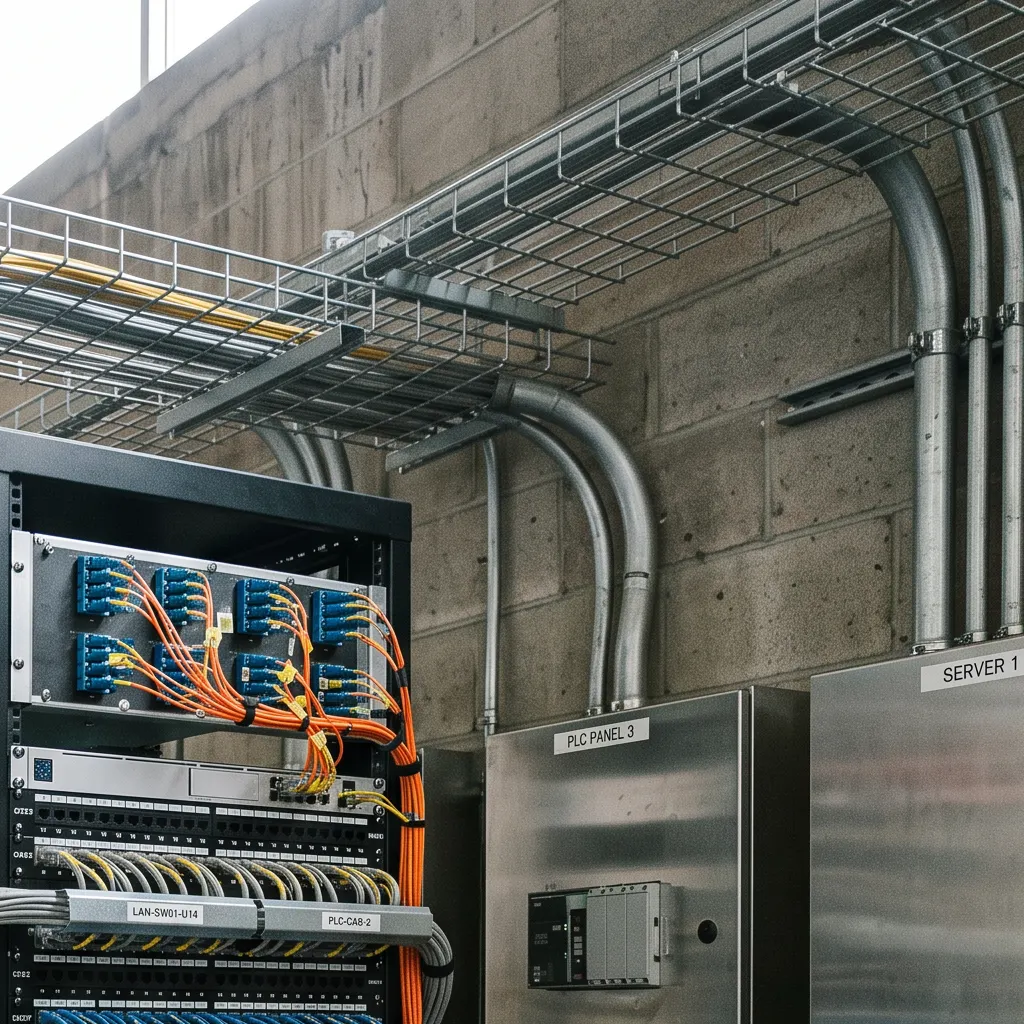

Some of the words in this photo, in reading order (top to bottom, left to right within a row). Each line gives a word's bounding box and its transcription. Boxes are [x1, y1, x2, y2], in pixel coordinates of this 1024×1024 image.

[943, 658, 1004, 682] SERVER
[1011, 655, 1017, 671] 1
[567, 733, 587, 748] PLC
[589, 727, 624, 744] PANEL
[627, 725, 634, 738] 3
[132, 907, 198, 919] LAN-SW01-U14
